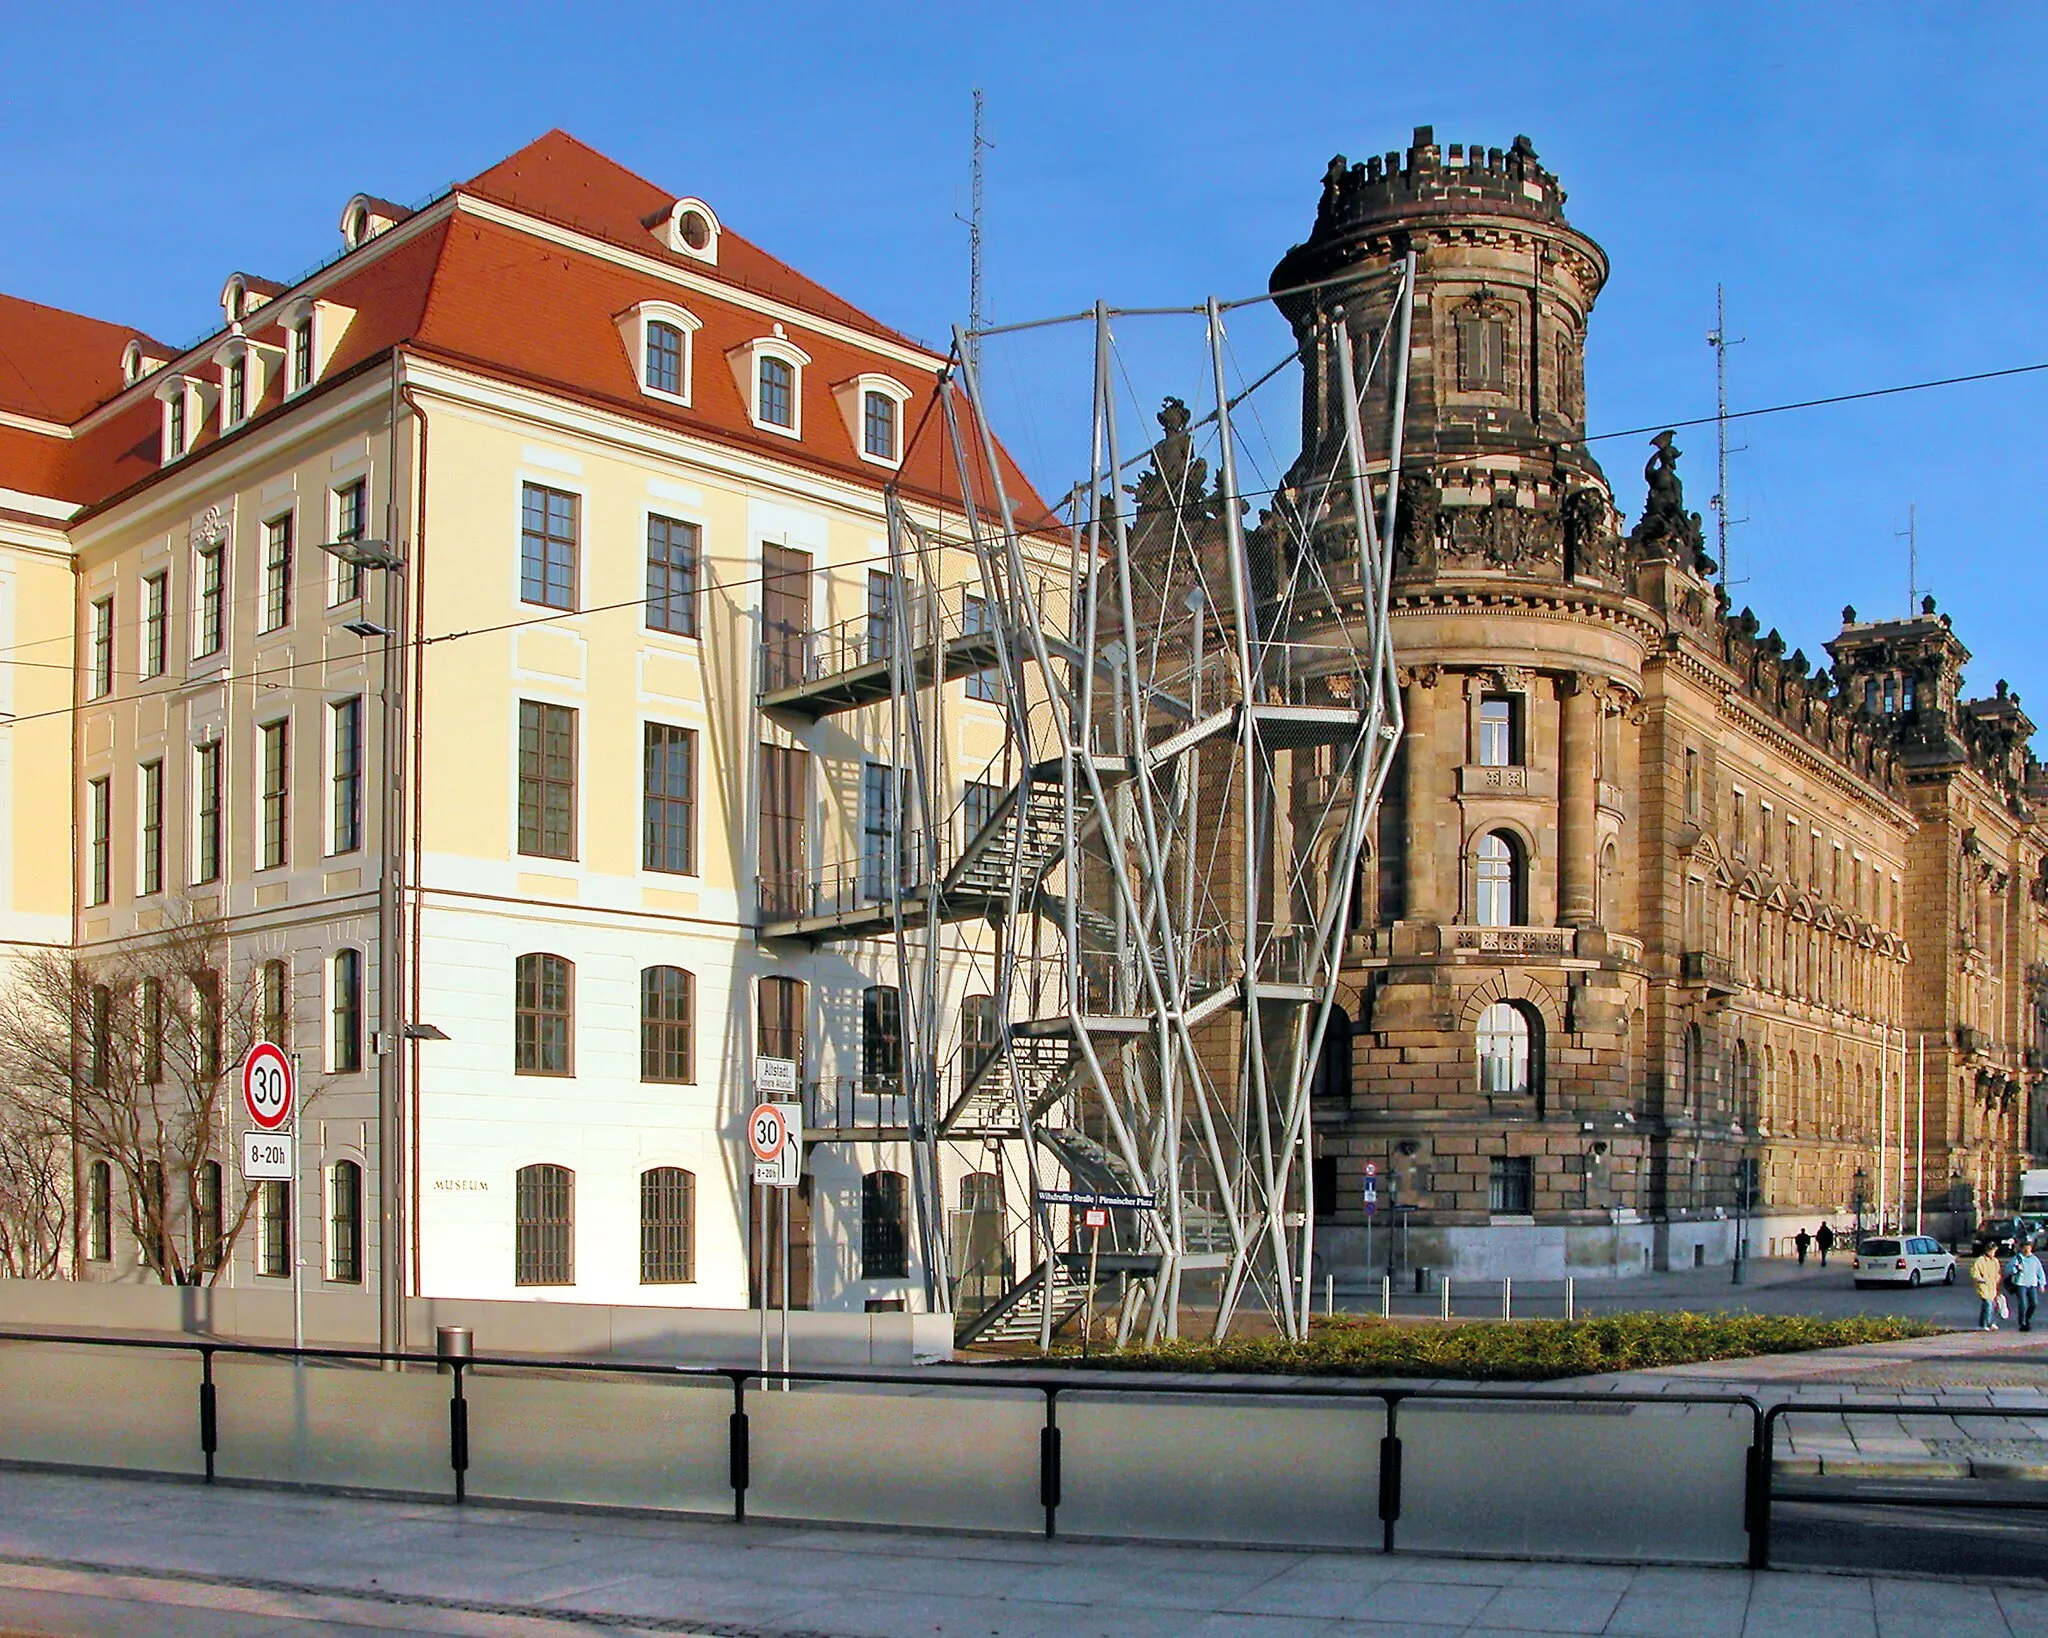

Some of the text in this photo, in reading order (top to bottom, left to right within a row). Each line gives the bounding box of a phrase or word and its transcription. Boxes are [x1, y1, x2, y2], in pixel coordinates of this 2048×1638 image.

[254, 1066, 282, 1106] 30
[757, 1119, 777, 1145] 30
[251, 1145, 285, 1165] 8-20h
[433, 1179, 488, 1191] MUSEUM
